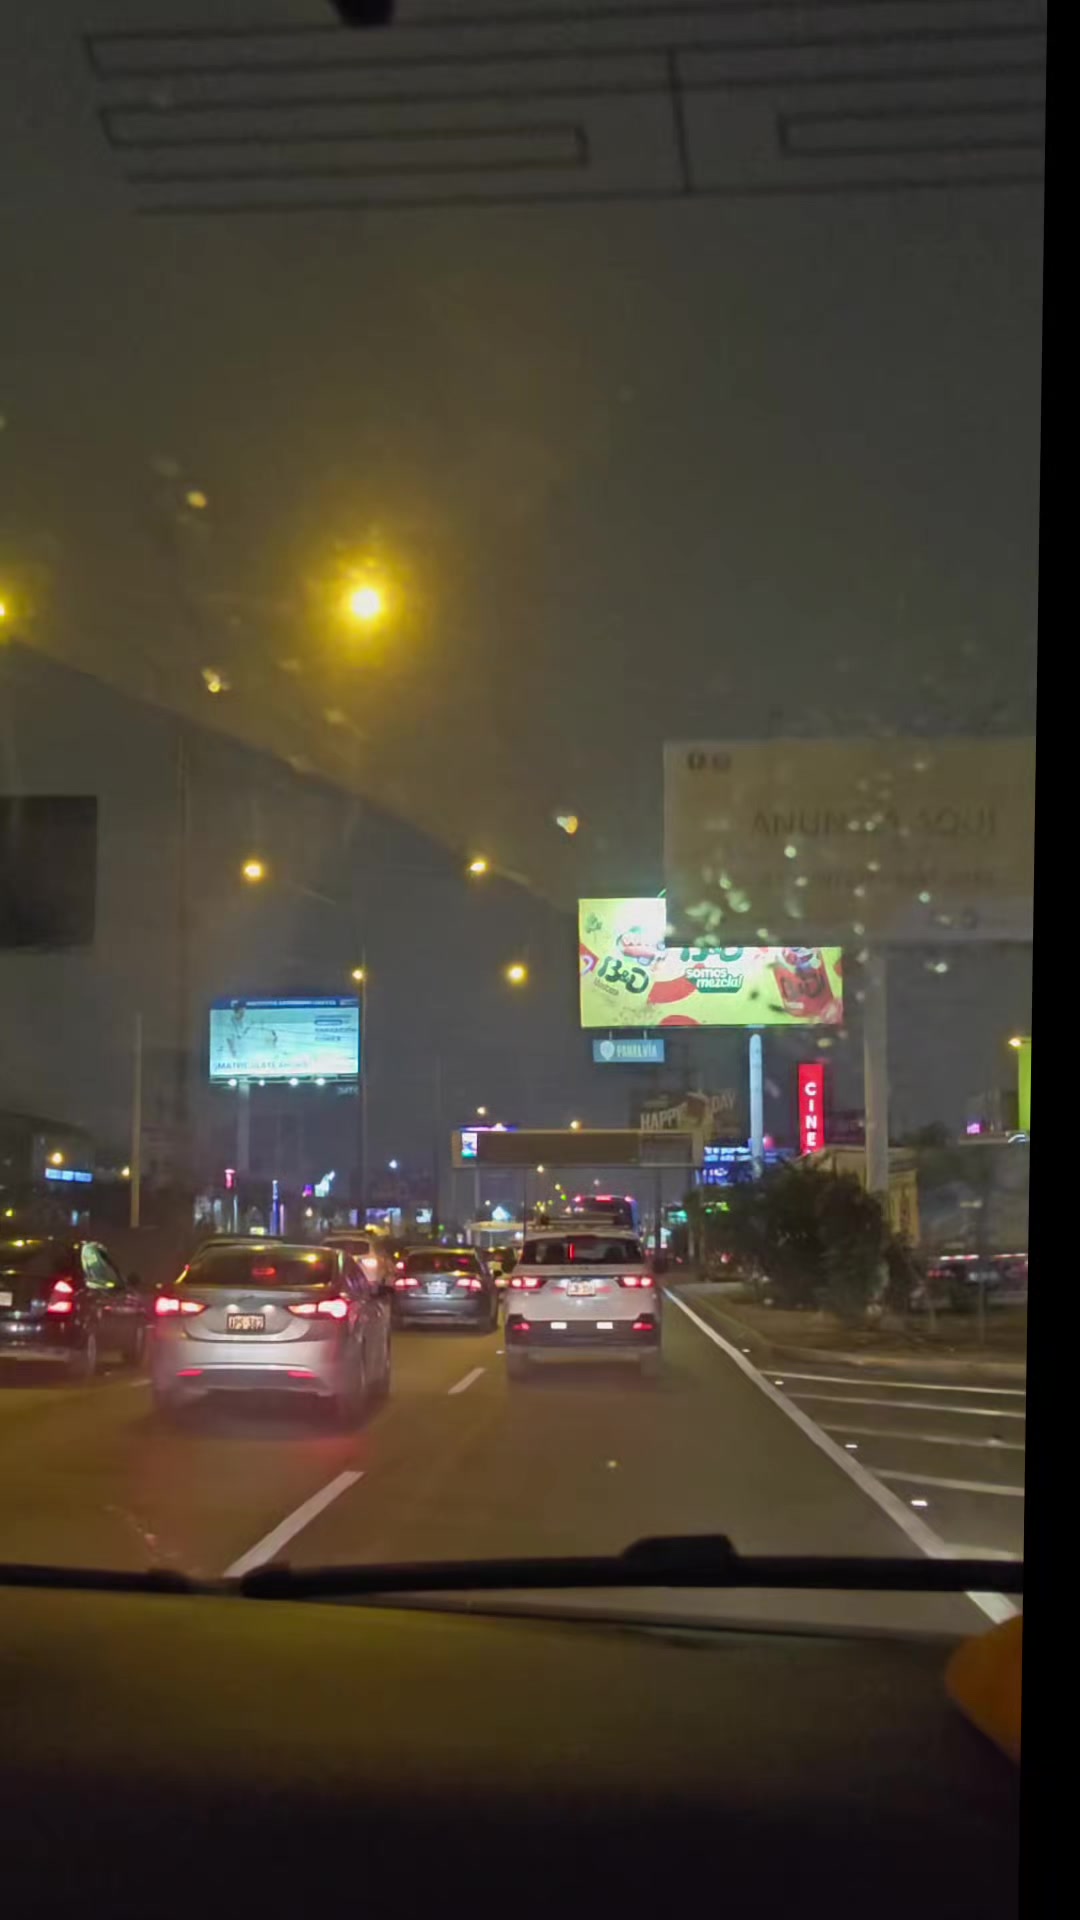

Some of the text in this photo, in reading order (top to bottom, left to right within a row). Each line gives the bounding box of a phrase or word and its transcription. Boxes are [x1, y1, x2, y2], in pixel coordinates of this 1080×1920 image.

[751, 809, 900, 836] ANUNA
[686, 967, 728, 978] somos
[696, 974, 744, 988] mezcla!
[640, 1107, 682, 1131] HAPPY
